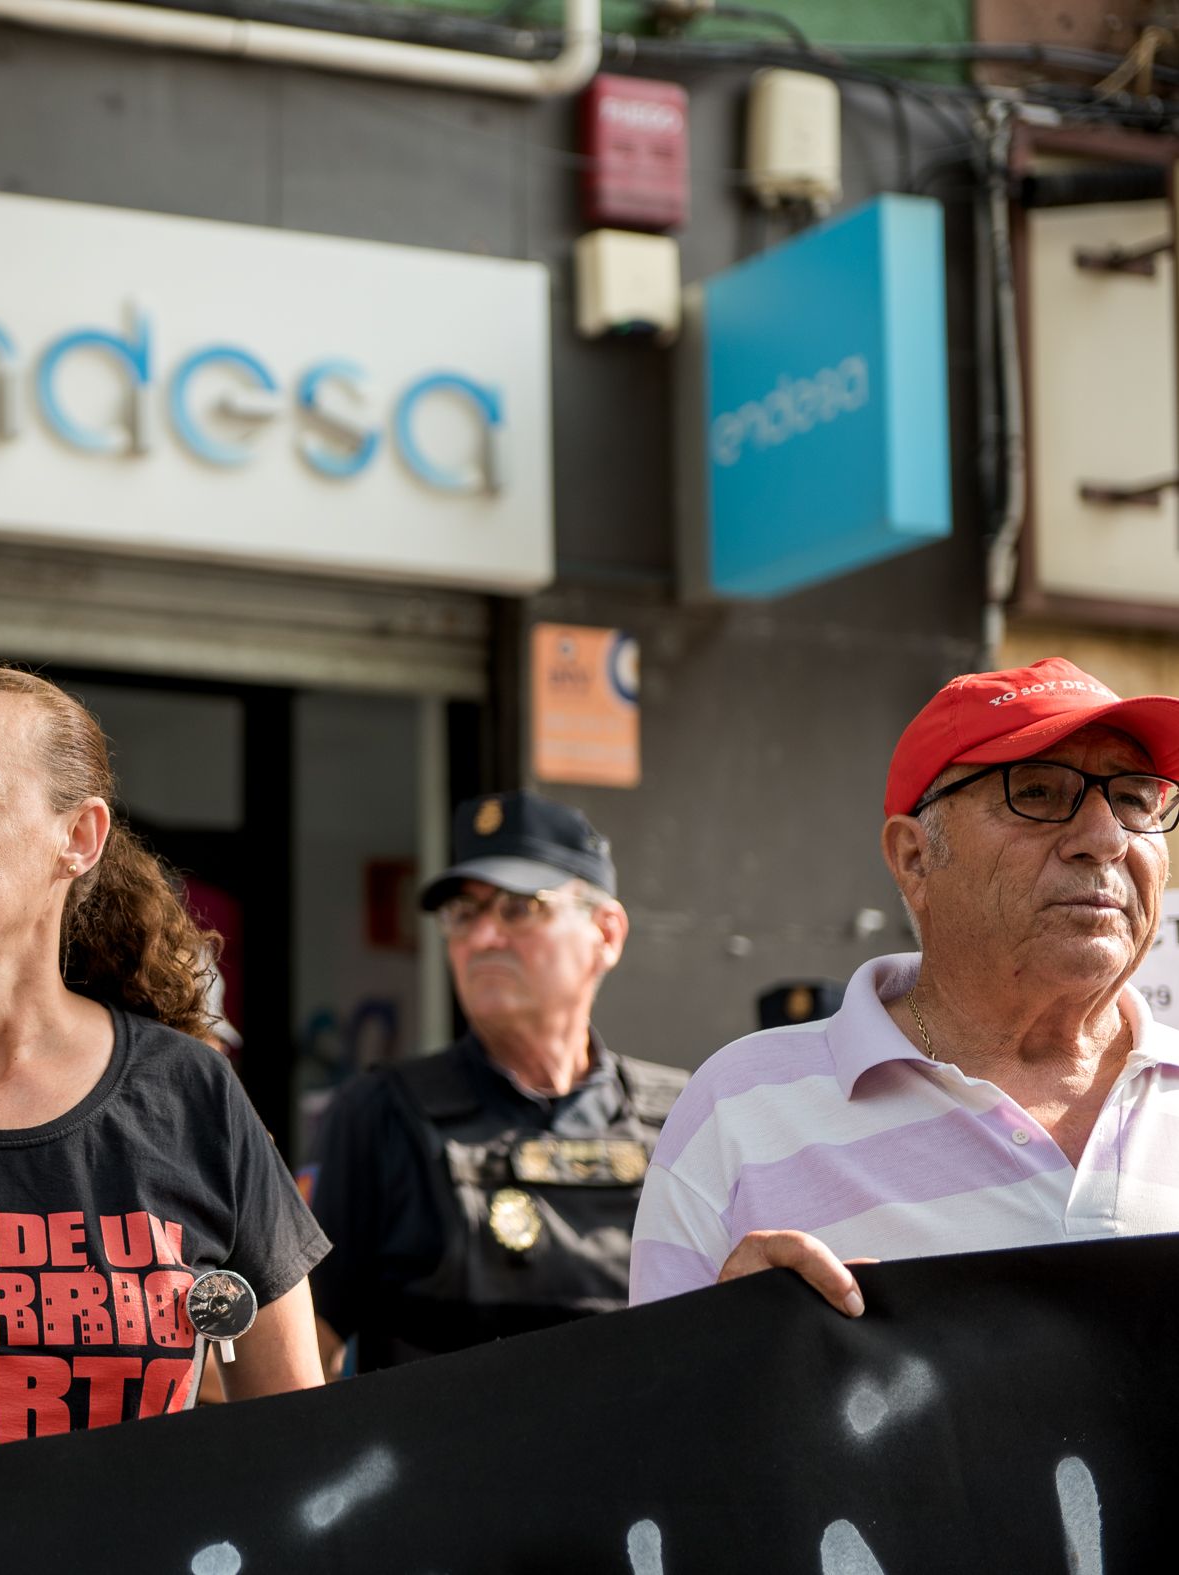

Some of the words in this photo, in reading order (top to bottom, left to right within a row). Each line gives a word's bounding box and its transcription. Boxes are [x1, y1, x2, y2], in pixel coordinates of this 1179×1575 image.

[712, 355, 869, 467] endesa
[989, 691, 1017, 706] YO
[1021, 681, 1057, 696] SOY
[1060, 680, 1087, 691] DE
[99, 1212, 189, 1270] UN
